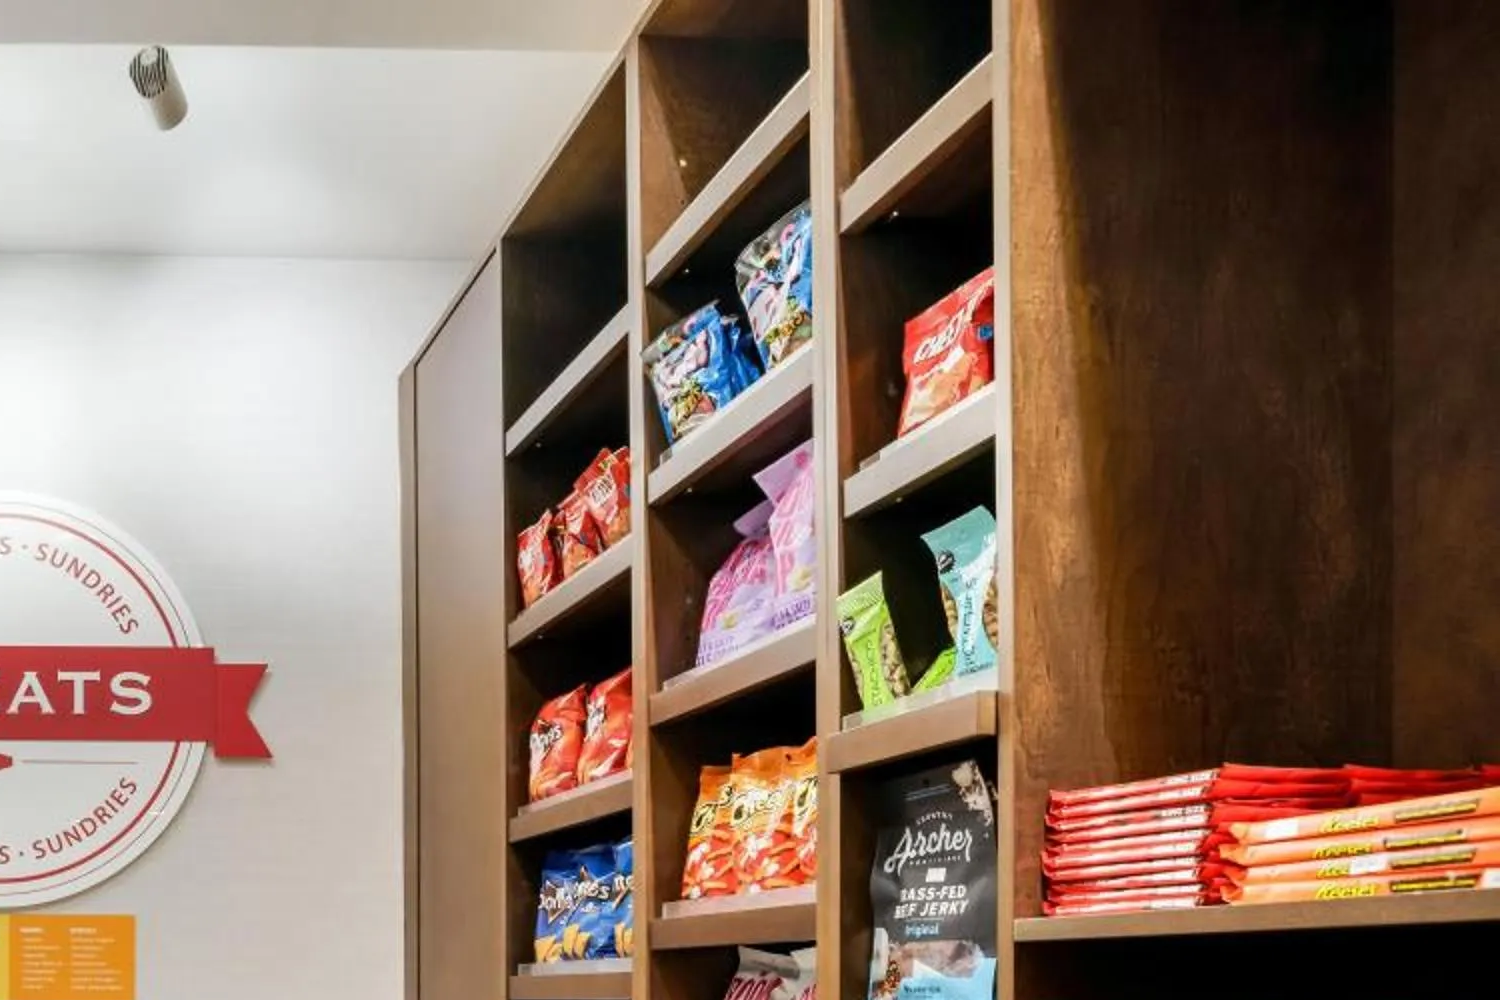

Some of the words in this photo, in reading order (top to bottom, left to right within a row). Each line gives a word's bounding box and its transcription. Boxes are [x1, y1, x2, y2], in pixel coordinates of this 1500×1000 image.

[35, 542, 140, 636] SUNDRIES
[32, 777, 139, 861] SUNDRIES
[884, 823, 973, 877] Archer
[900, 885, 967, 902] RASS-FED
[920, 899, 970, 917] JERKY
